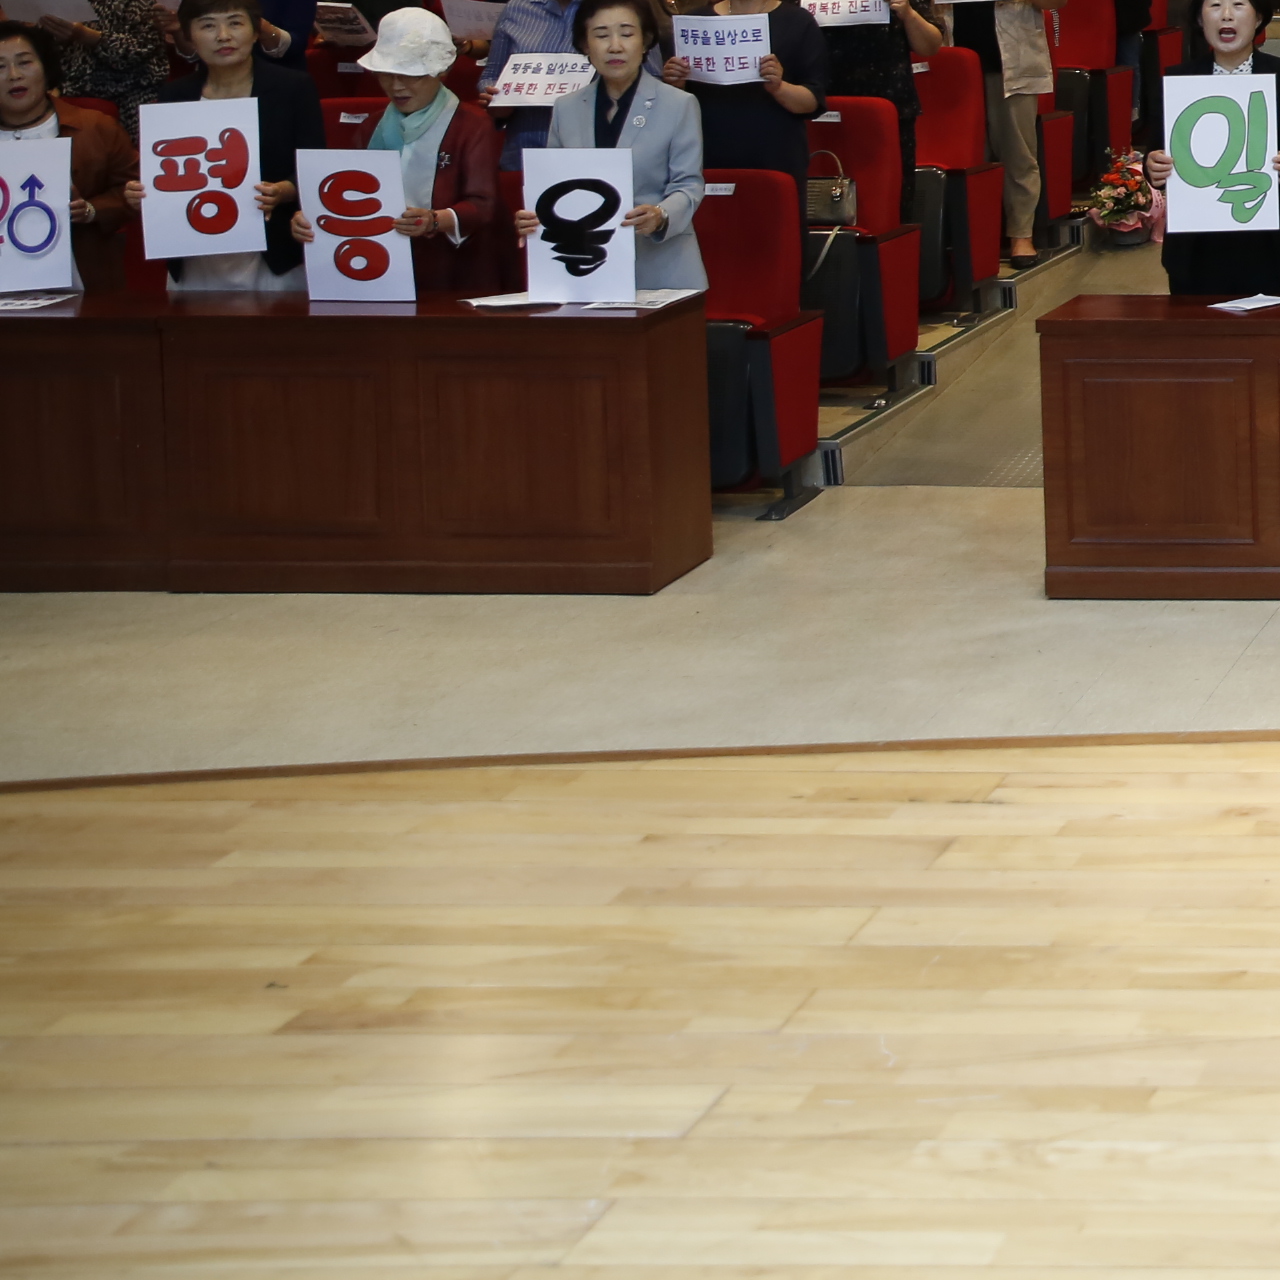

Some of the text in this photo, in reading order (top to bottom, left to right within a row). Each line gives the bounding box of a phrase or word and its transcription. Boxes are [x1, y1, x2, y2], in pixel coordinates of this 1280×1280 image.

[680, 28, 763, 45] 평등을 일상으로
[807, 0, 882, 15] 행복한 진도!!
[501, 82, 538, 96] 행복한
[510, 62, 591, 76] 평등을 일상으로
[153, 127, 249, 235] 평
[1169, 90, 1268, 223] 일
[317, 170, 394, 282] 등
[535, 178, 622, 277] 을
